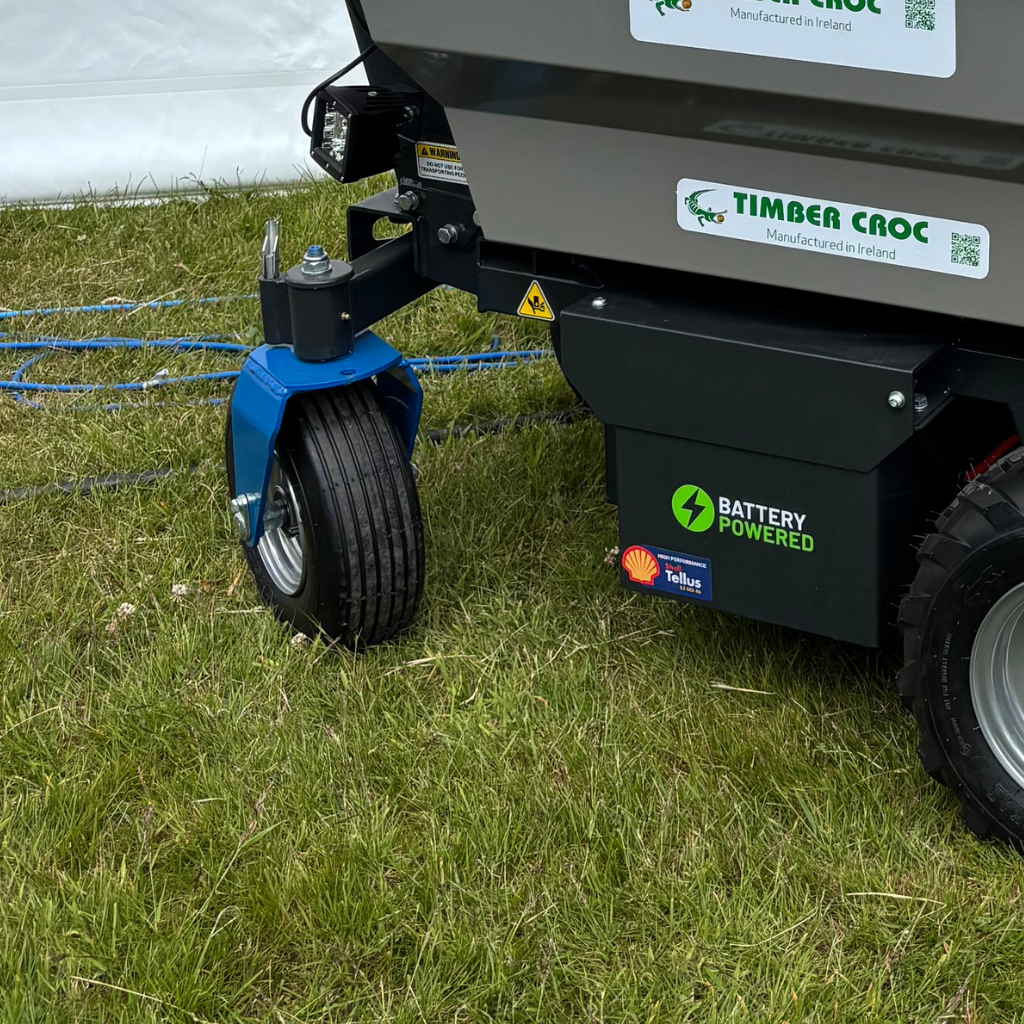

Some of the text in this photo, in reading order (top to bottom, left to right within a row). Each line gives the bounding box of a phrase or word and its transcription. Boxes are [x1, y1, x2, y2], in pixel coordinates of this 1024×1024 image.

[730, 7, 852, 32] Manufactured in Ireland
[733, 191, 928, 244] TIMBER CROC
[766, 228, 896, 260] Manufactured in Ireland
[719, 496, 807, 531] BATTERY
[719, 515, 814, 552] POWERED
[665, 569, 702, 588] Tellus
[670, 556, 707, 569] PERFORMANCE
